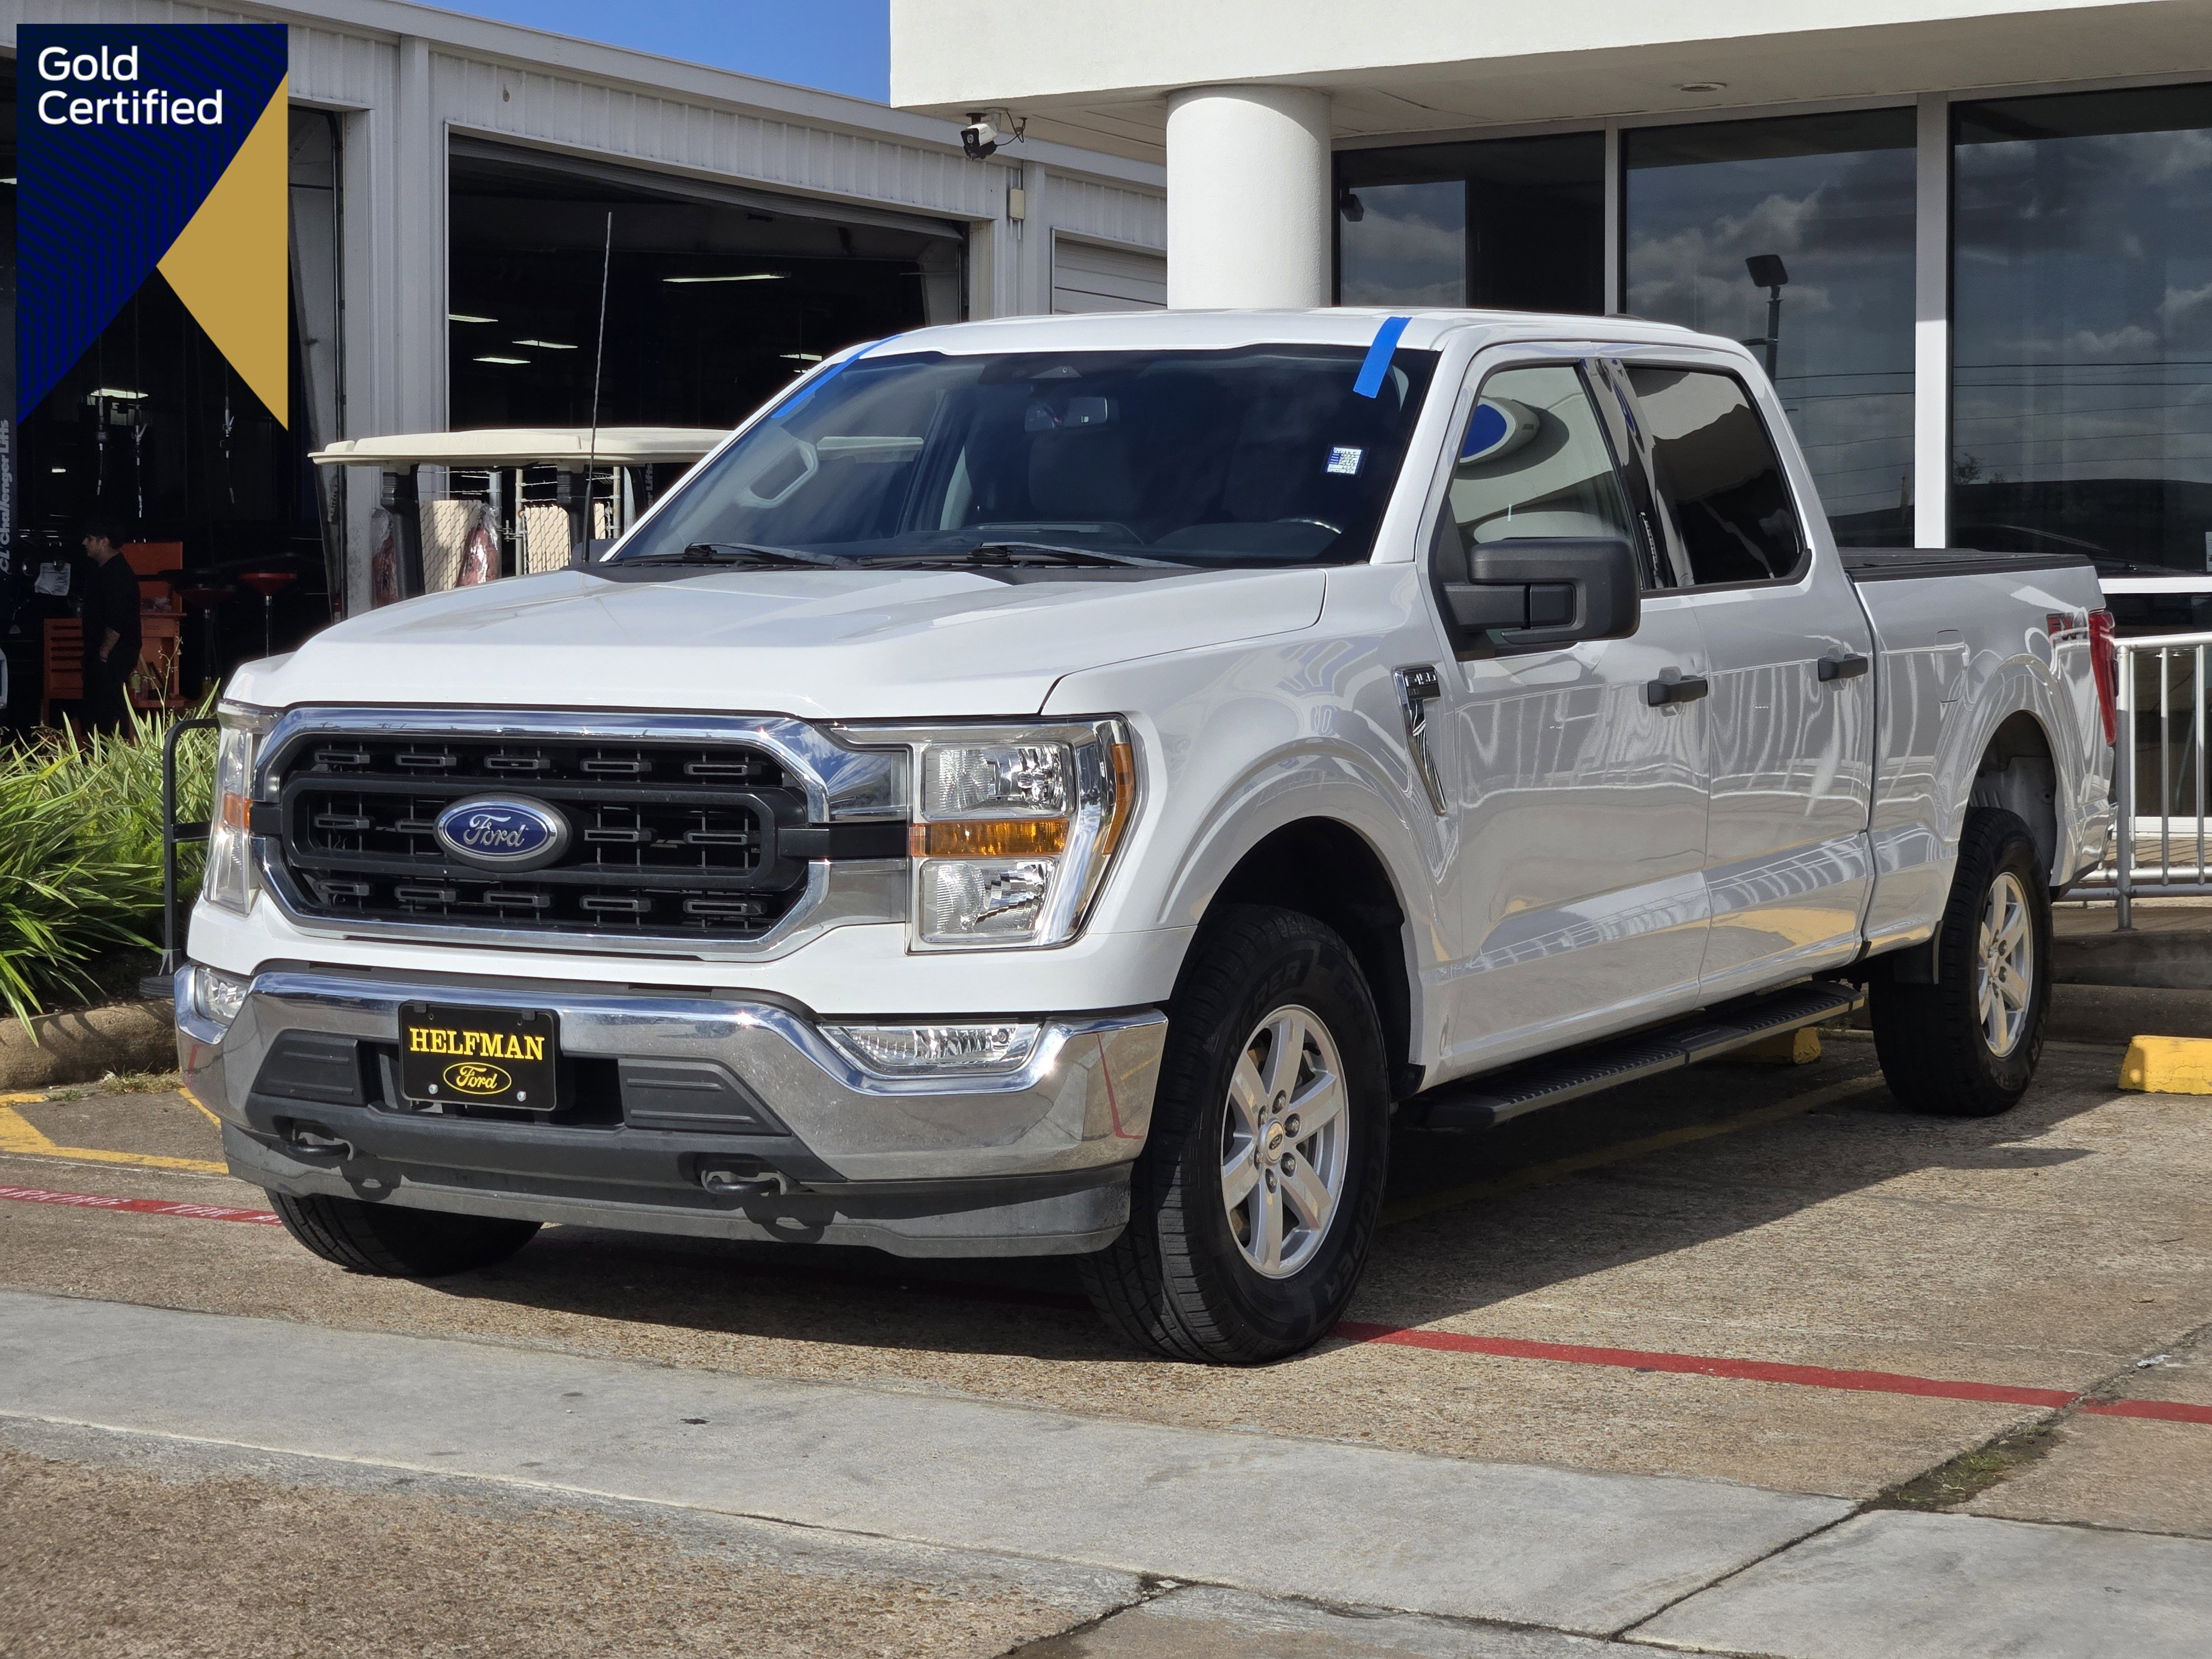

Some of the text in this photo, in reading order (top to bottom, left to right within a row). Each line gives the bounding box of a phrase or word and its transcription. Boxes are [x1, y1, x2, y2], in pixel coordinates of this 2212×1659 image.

[0, 419, 9, 453] Lifts
[0, 455, 12, 545] Challenger
[463, 814, 529, 847] Ford
[409, 1026, 545, 1060] HELFMAN
[456, 1065, 497, 1089] Ford
